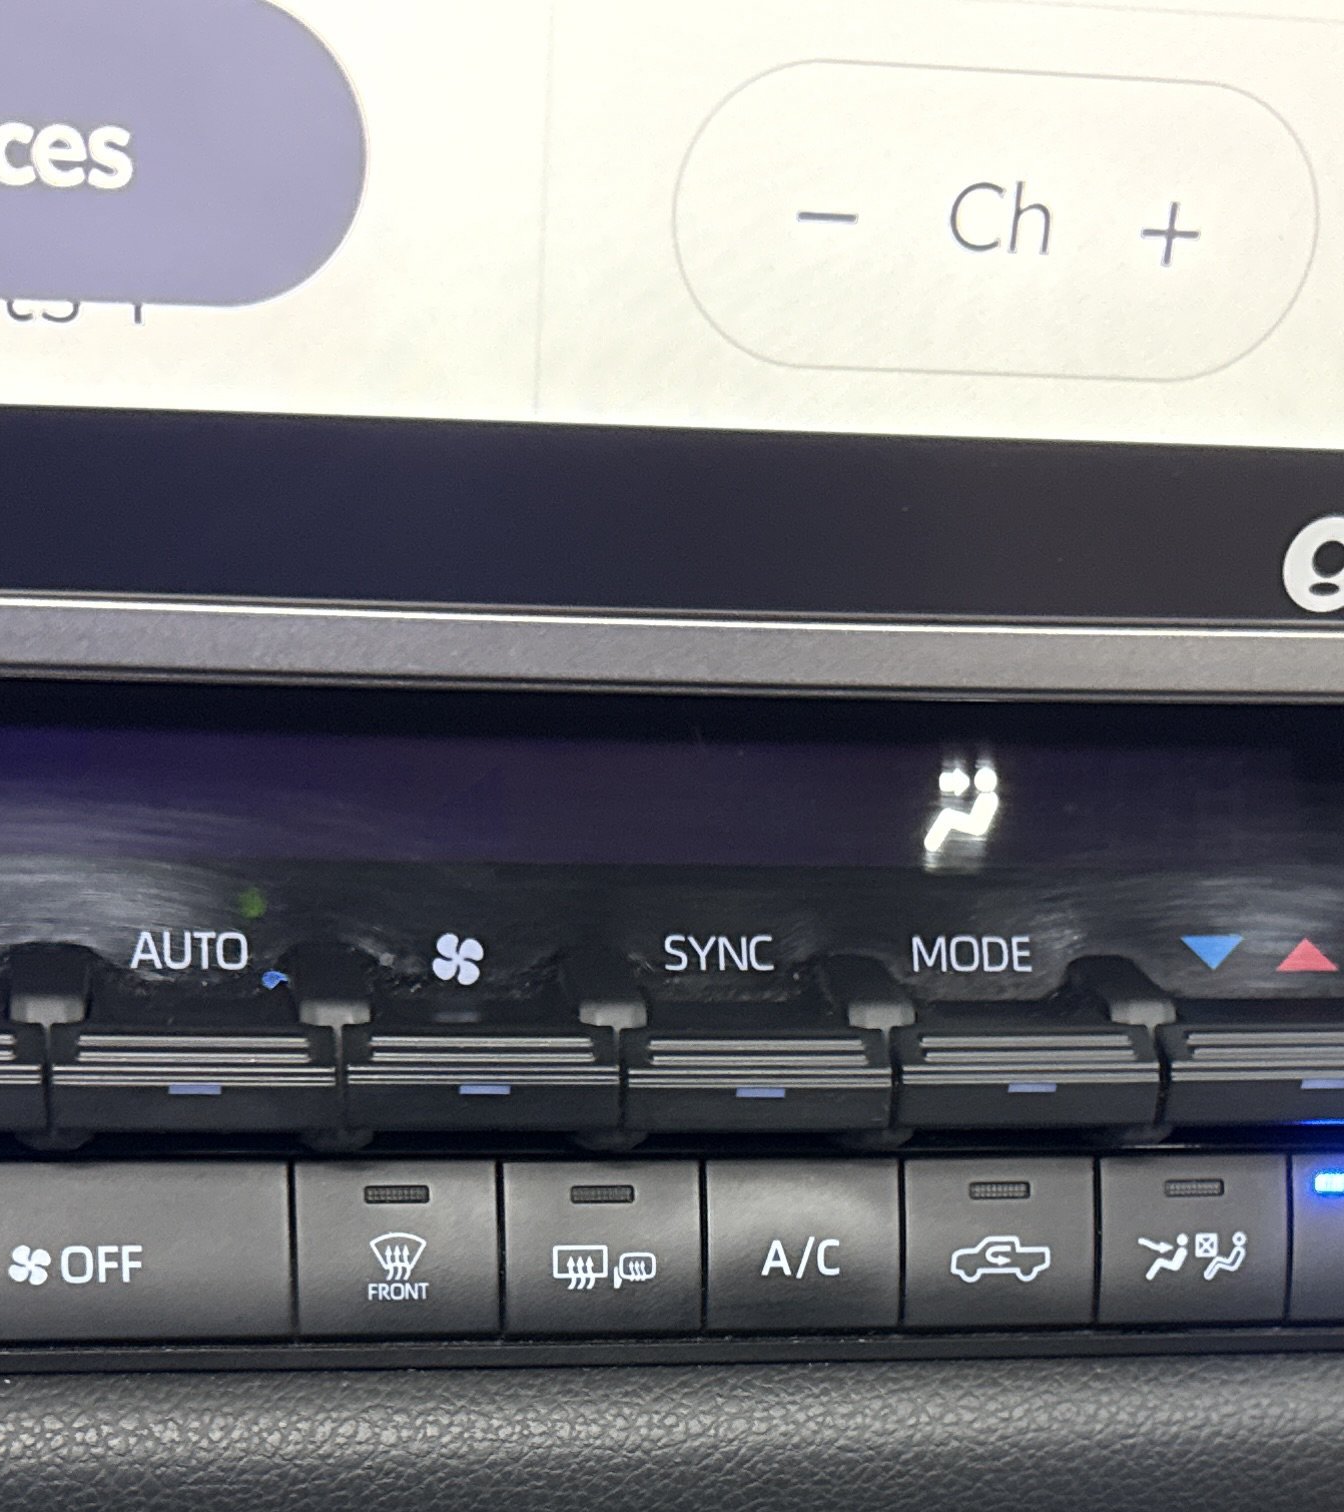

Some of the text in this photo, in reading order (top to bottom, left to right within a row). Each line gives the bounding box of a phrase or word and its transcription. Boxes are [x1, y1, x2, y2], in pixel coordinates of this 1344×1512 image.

[949, 181, 1052, 255] Ch
[131, 930, 249, 973] AUTO
[664, 934, 775, 973] SYNC
[911, 935, 1034, 974] MODE
[60, 1244, 144, 1284] OFF
[761, 1237, 842, 1279] A/C
[367, 1282, 428, 1301] FRONT
